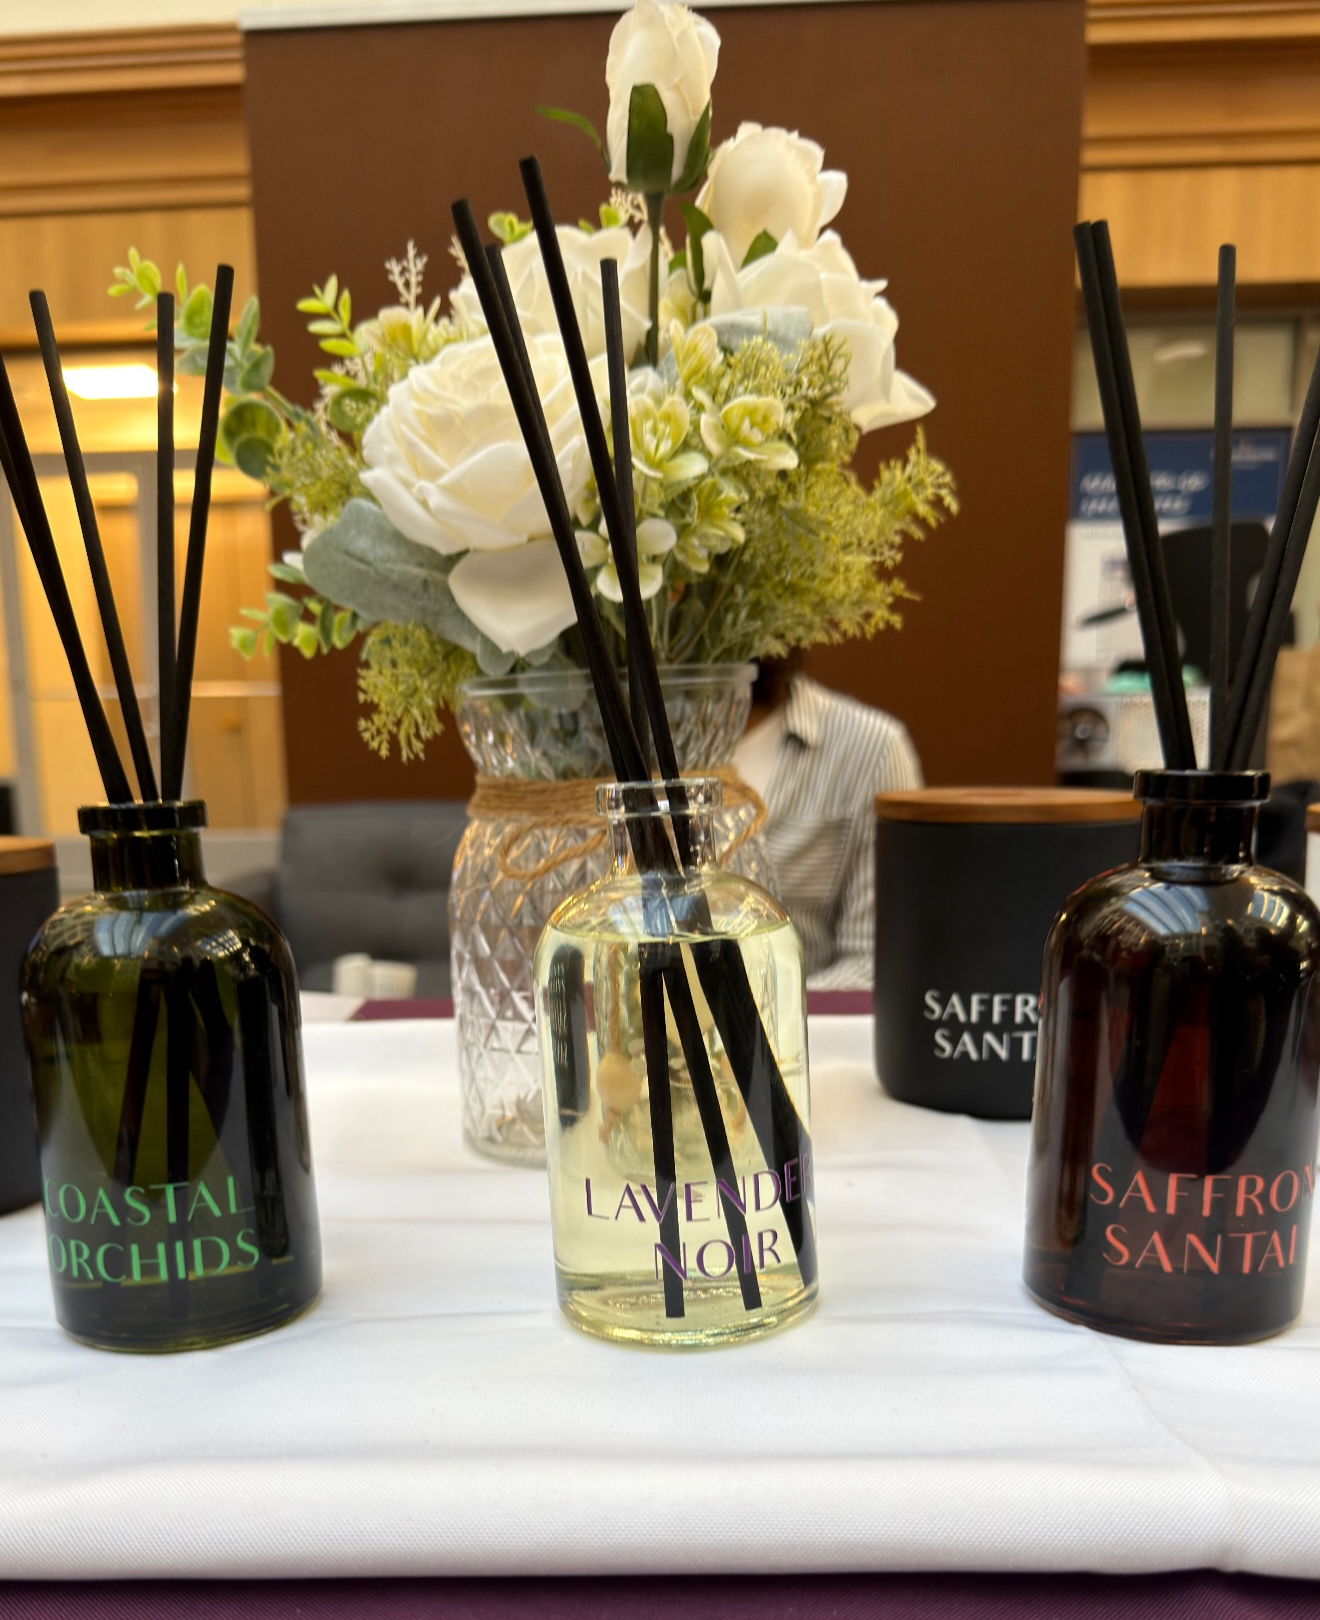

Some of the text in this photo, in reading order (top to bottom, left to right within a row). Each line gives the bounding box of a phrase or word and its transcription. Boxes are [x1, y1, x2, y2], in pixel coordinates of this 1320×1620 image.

[923, 988, 1038, 1025] SAFFR
[933, 1027, 1037, 1062] SANT
[44, 1175, 256, 1226] COASTAL
[585, 1153, 811, 1224] LAVENDER
[49, 1228, 260, 1283] ORCHIDS
[654, 1228, 782, 1281] NOIR
